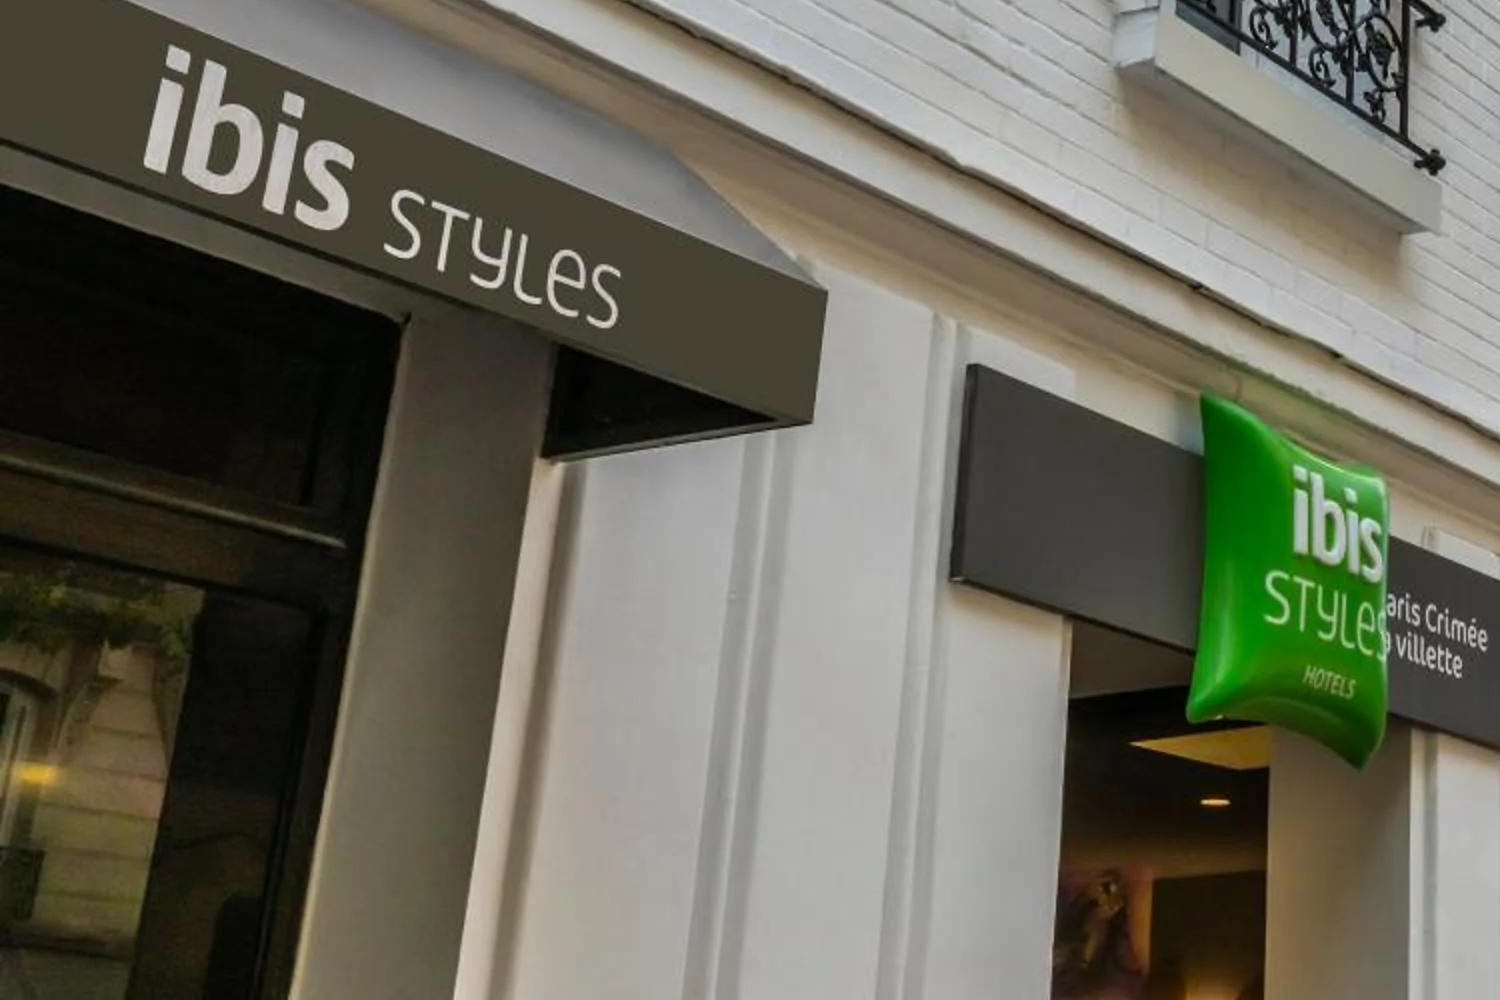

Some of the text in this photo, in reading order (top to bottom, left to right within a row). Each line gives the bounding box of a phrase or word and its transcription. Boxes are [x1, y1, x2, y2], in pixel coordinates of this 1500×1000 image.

[143, 44, 355, 231] ibis
[1293, 463, 1383, 583] ibis
[1386, 592, 1421, 627] aris
[1425, 603, 1489, 653] Crimée
[1303, 664, 1357, 699] HOTELS
[1395, 630, 1464, 679] villette
